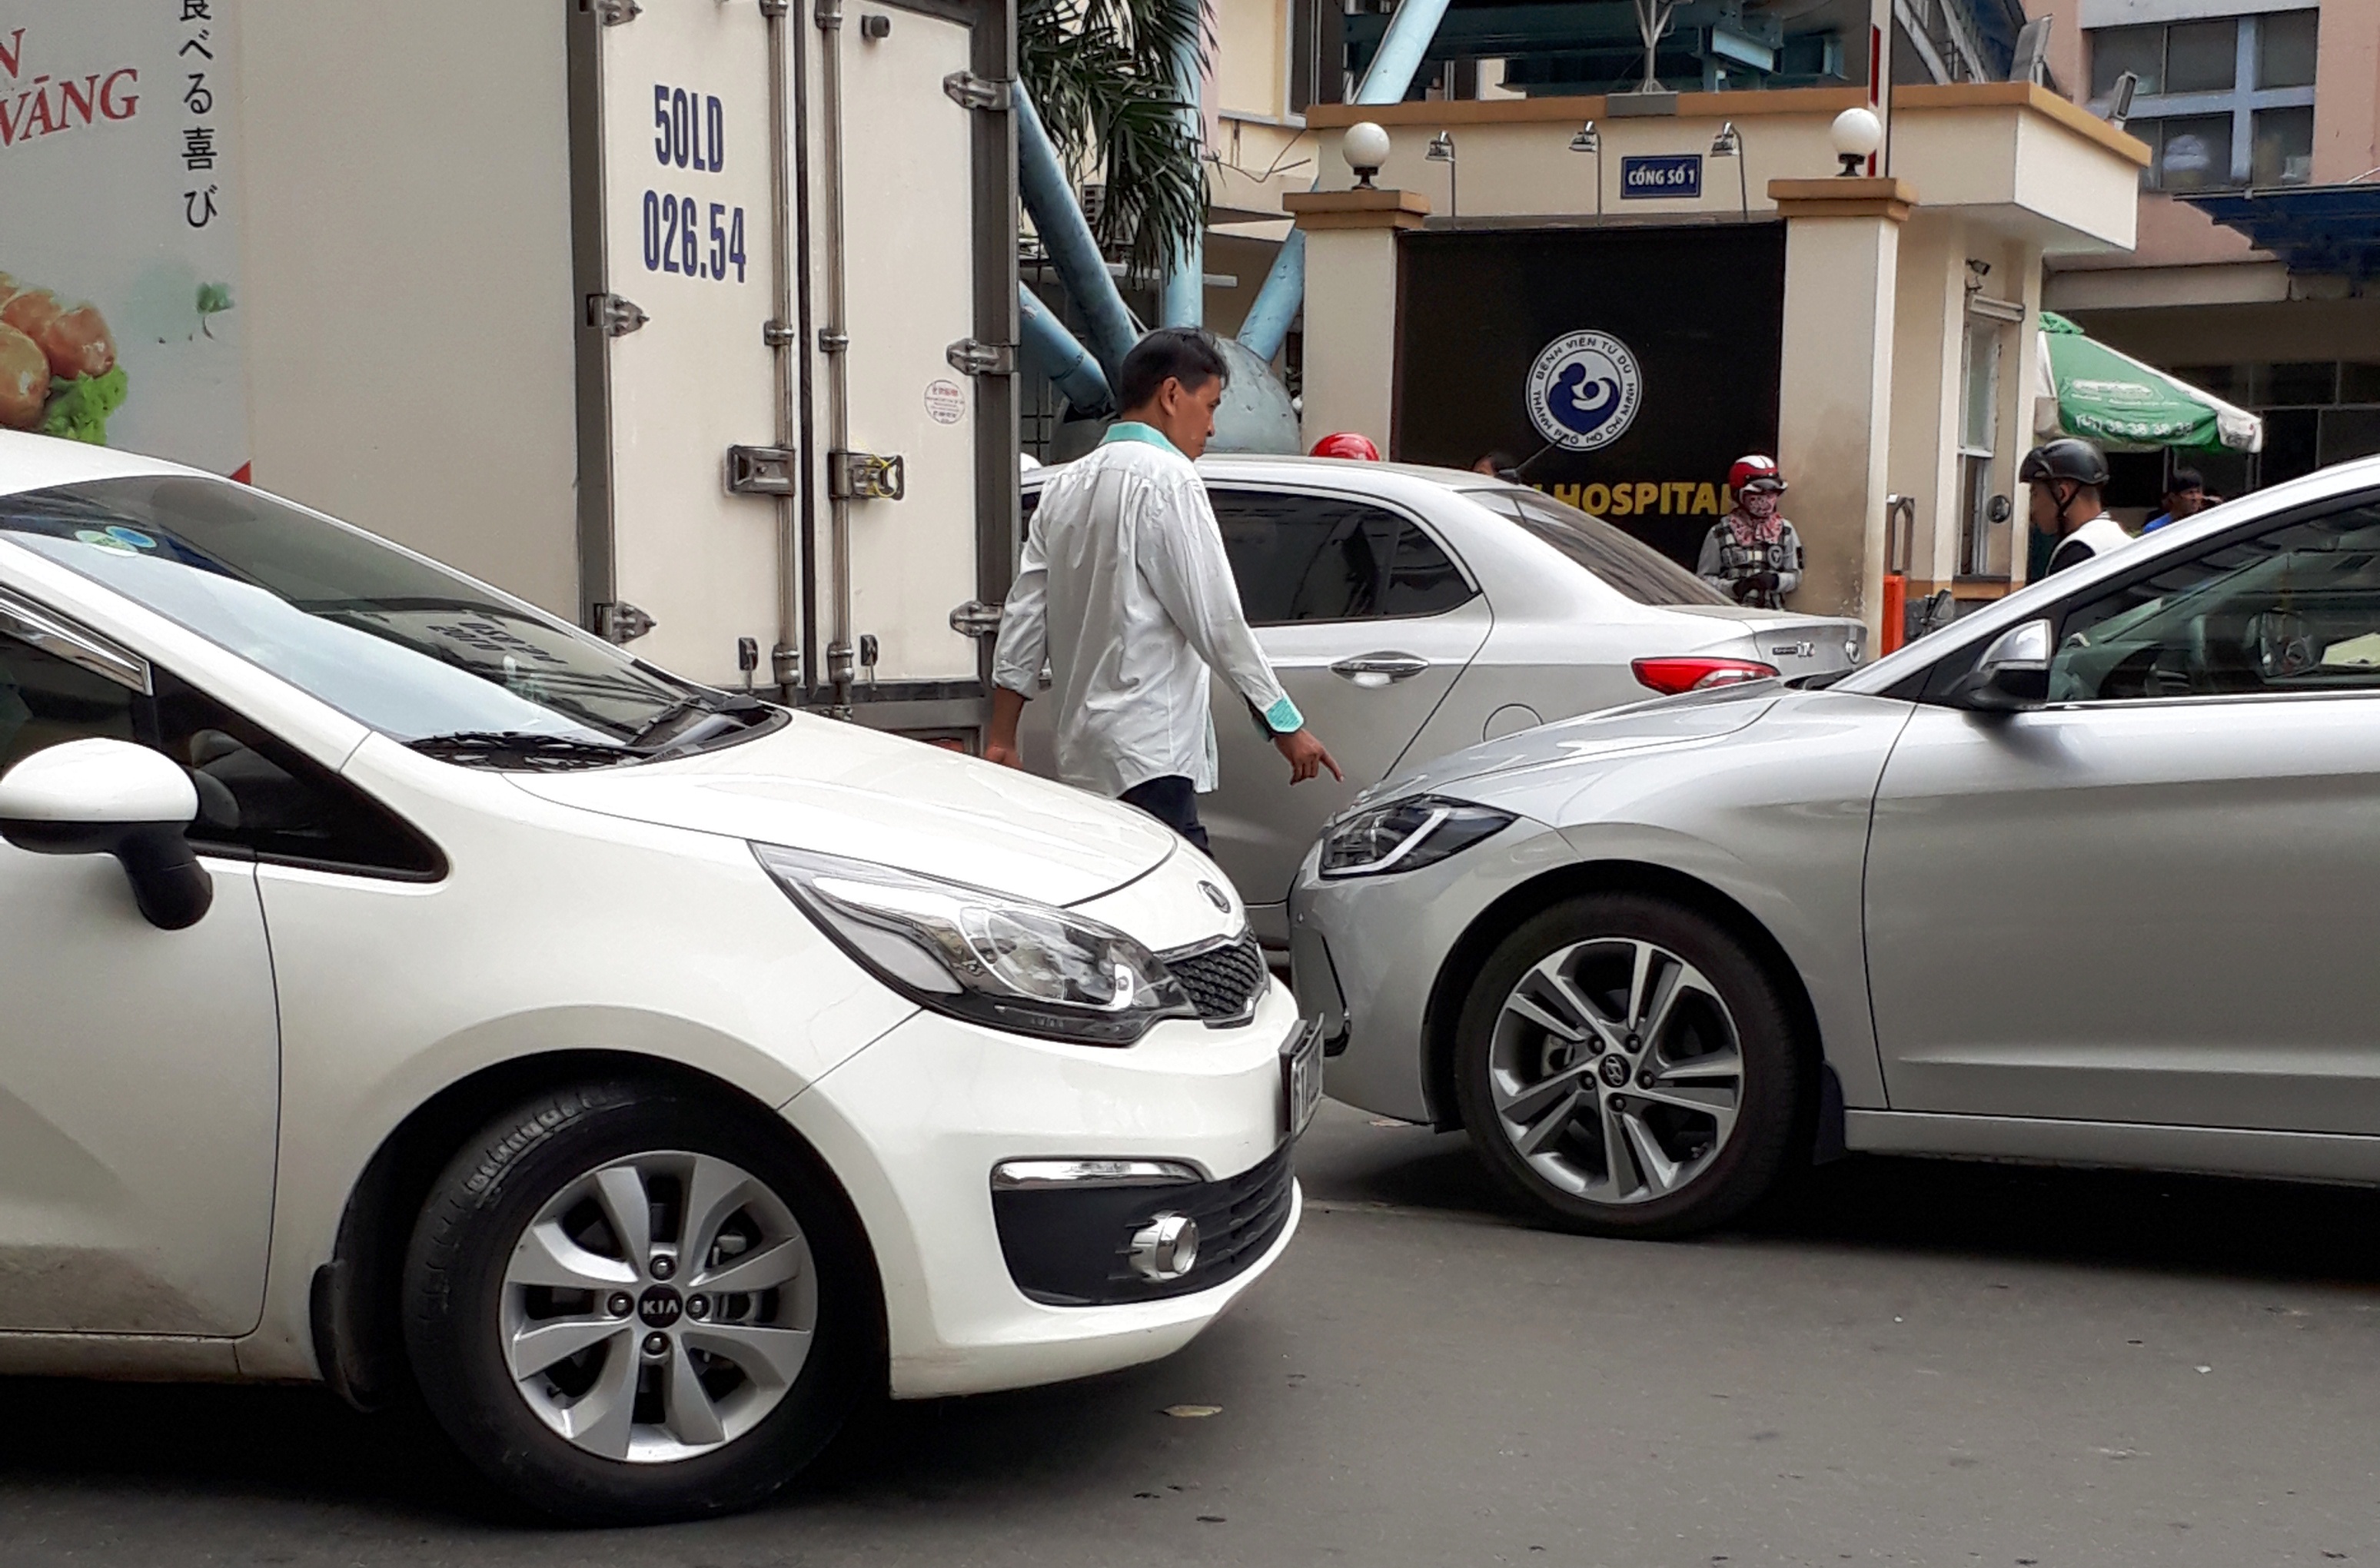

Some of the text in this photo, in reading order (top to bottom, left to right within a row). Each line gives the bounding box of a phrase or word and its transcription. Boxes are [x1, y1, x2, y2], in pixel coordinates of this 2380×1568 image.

[654, 84, 724, 174] 50LD
[1688, 168, 1695, 184] 1
[643, 189, 746, 284] 026.54
[643, 1299, 679, 1315] KIA
